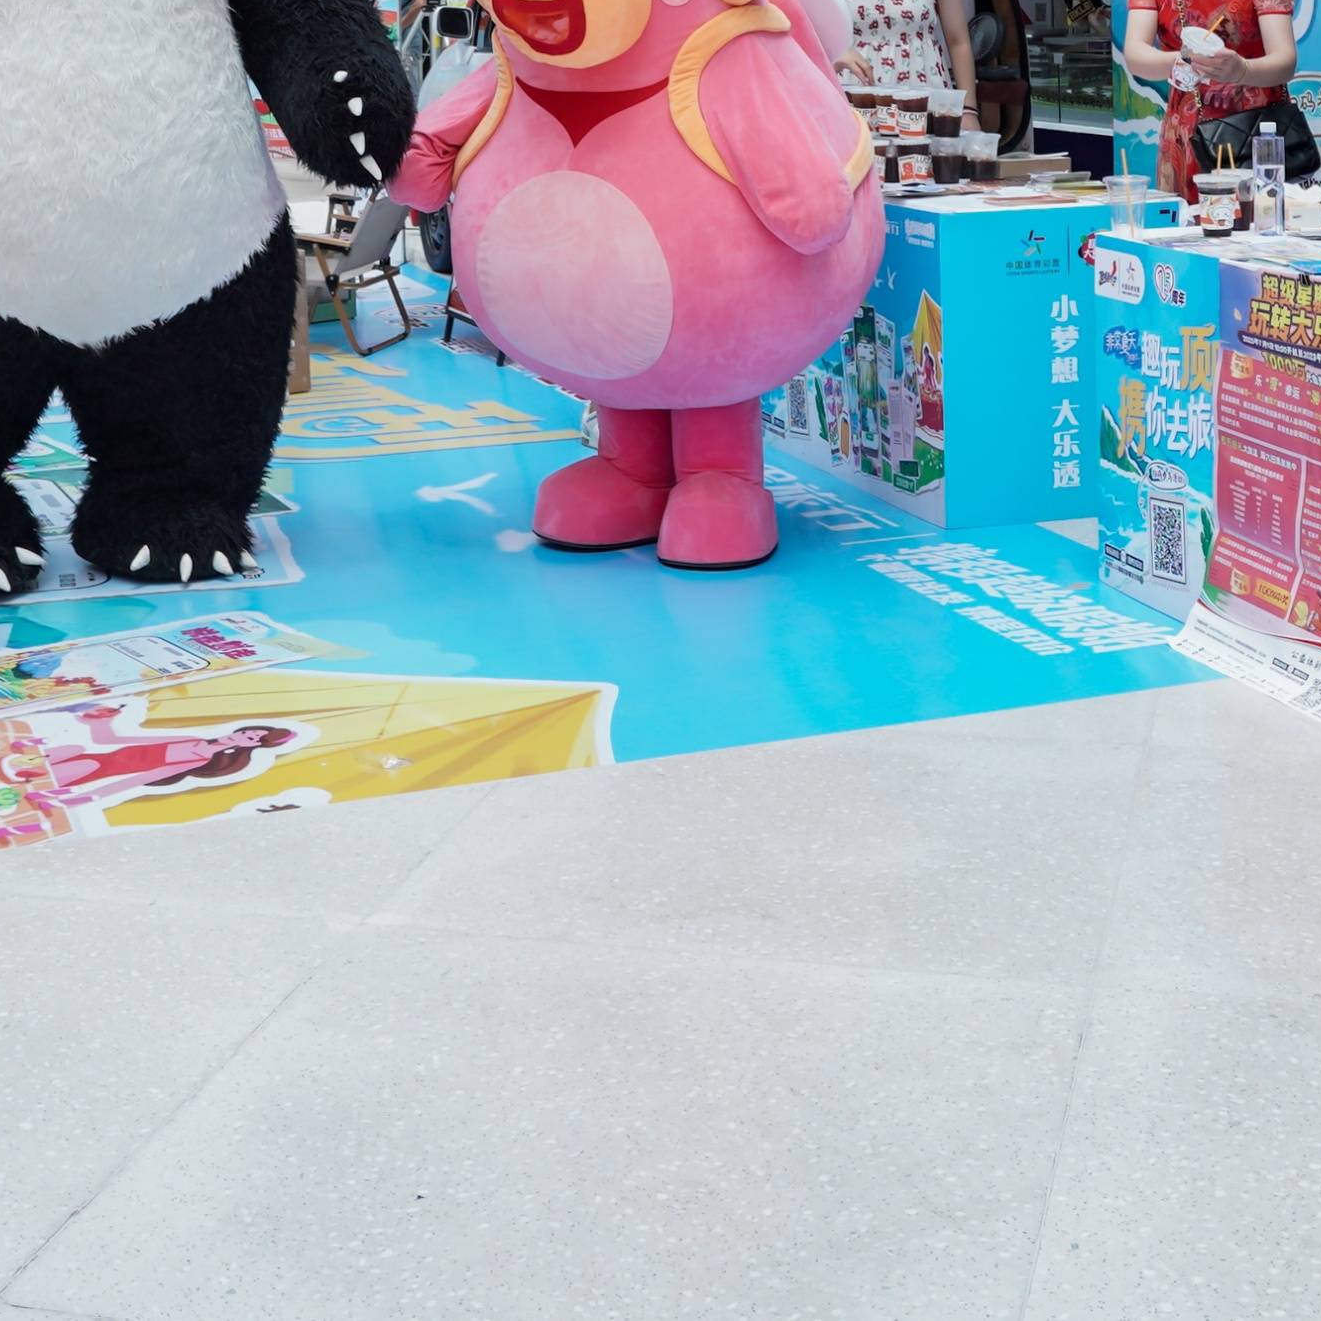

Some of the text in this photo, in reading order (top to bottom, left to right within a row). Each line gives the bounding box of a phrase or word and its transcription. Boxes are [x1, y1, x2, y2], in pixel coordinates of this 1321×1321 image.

[1050, 293, 1082, 489] 小梦想 大乐透
